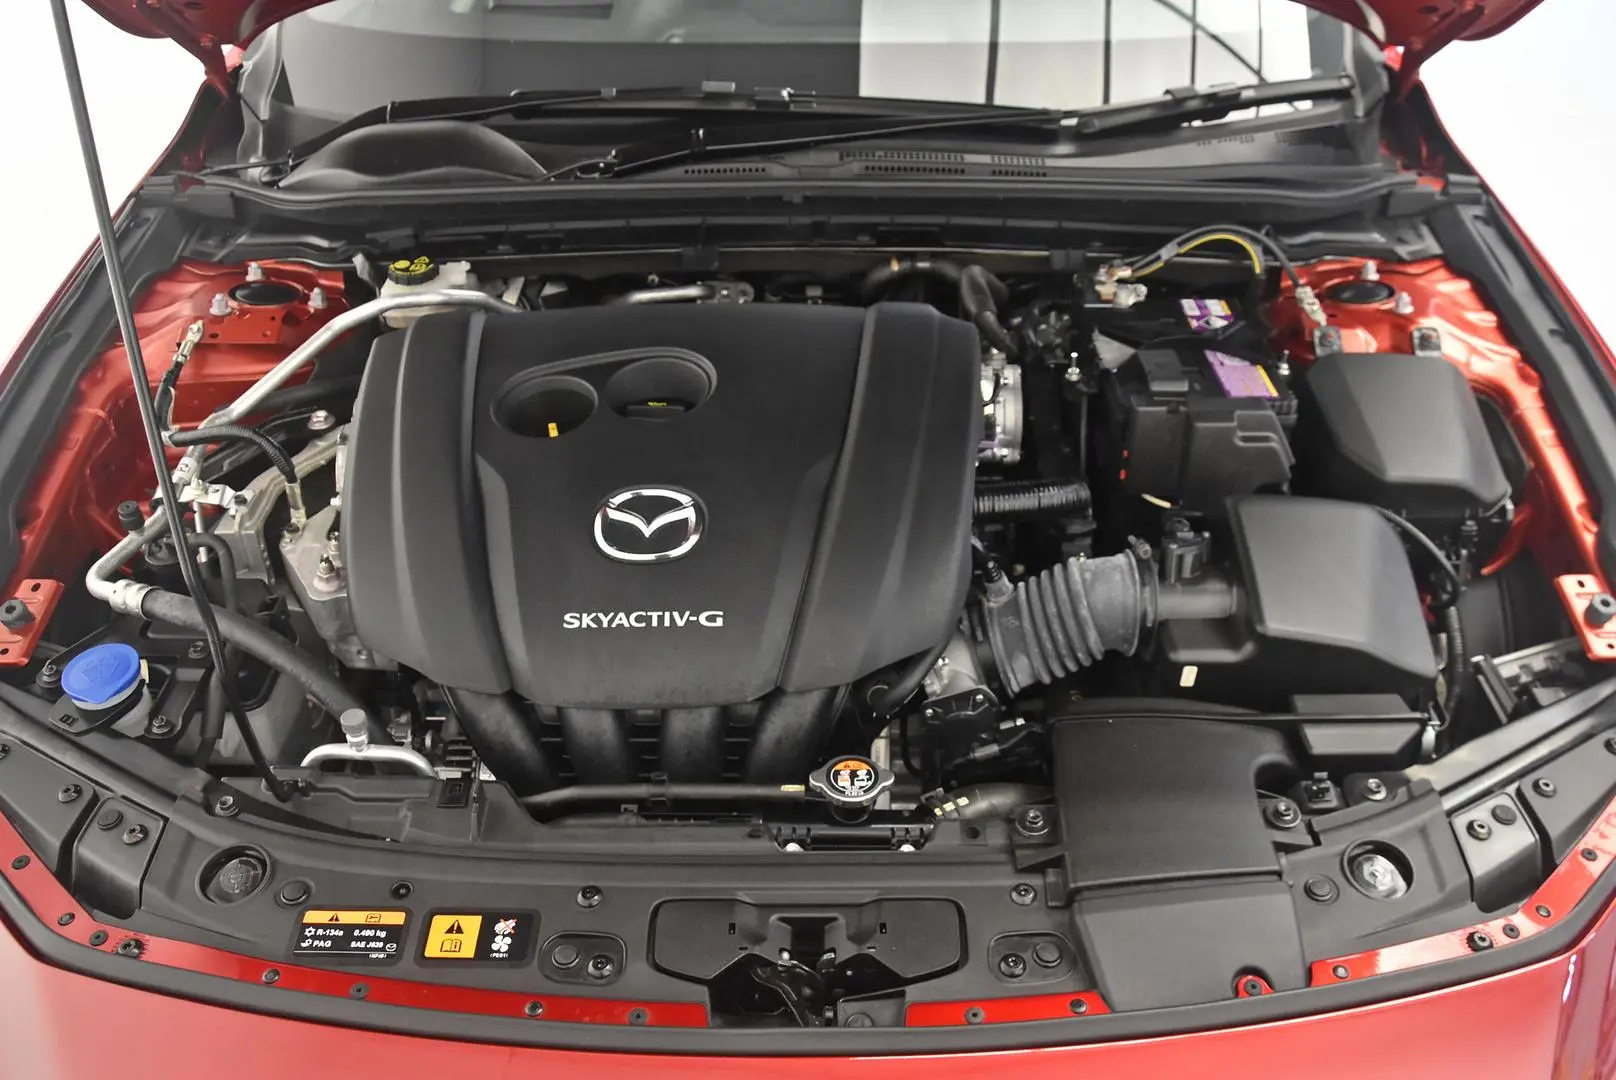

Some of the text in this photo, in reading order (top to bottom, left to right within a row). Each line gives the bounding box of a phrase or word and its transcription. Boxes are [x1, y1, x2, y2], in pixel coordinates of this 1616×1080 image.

[562, 610, 724, 629] SKYACTIV-G
[316, 928, 344, 937] R-134a
[375, 929, 387, 938] kg
